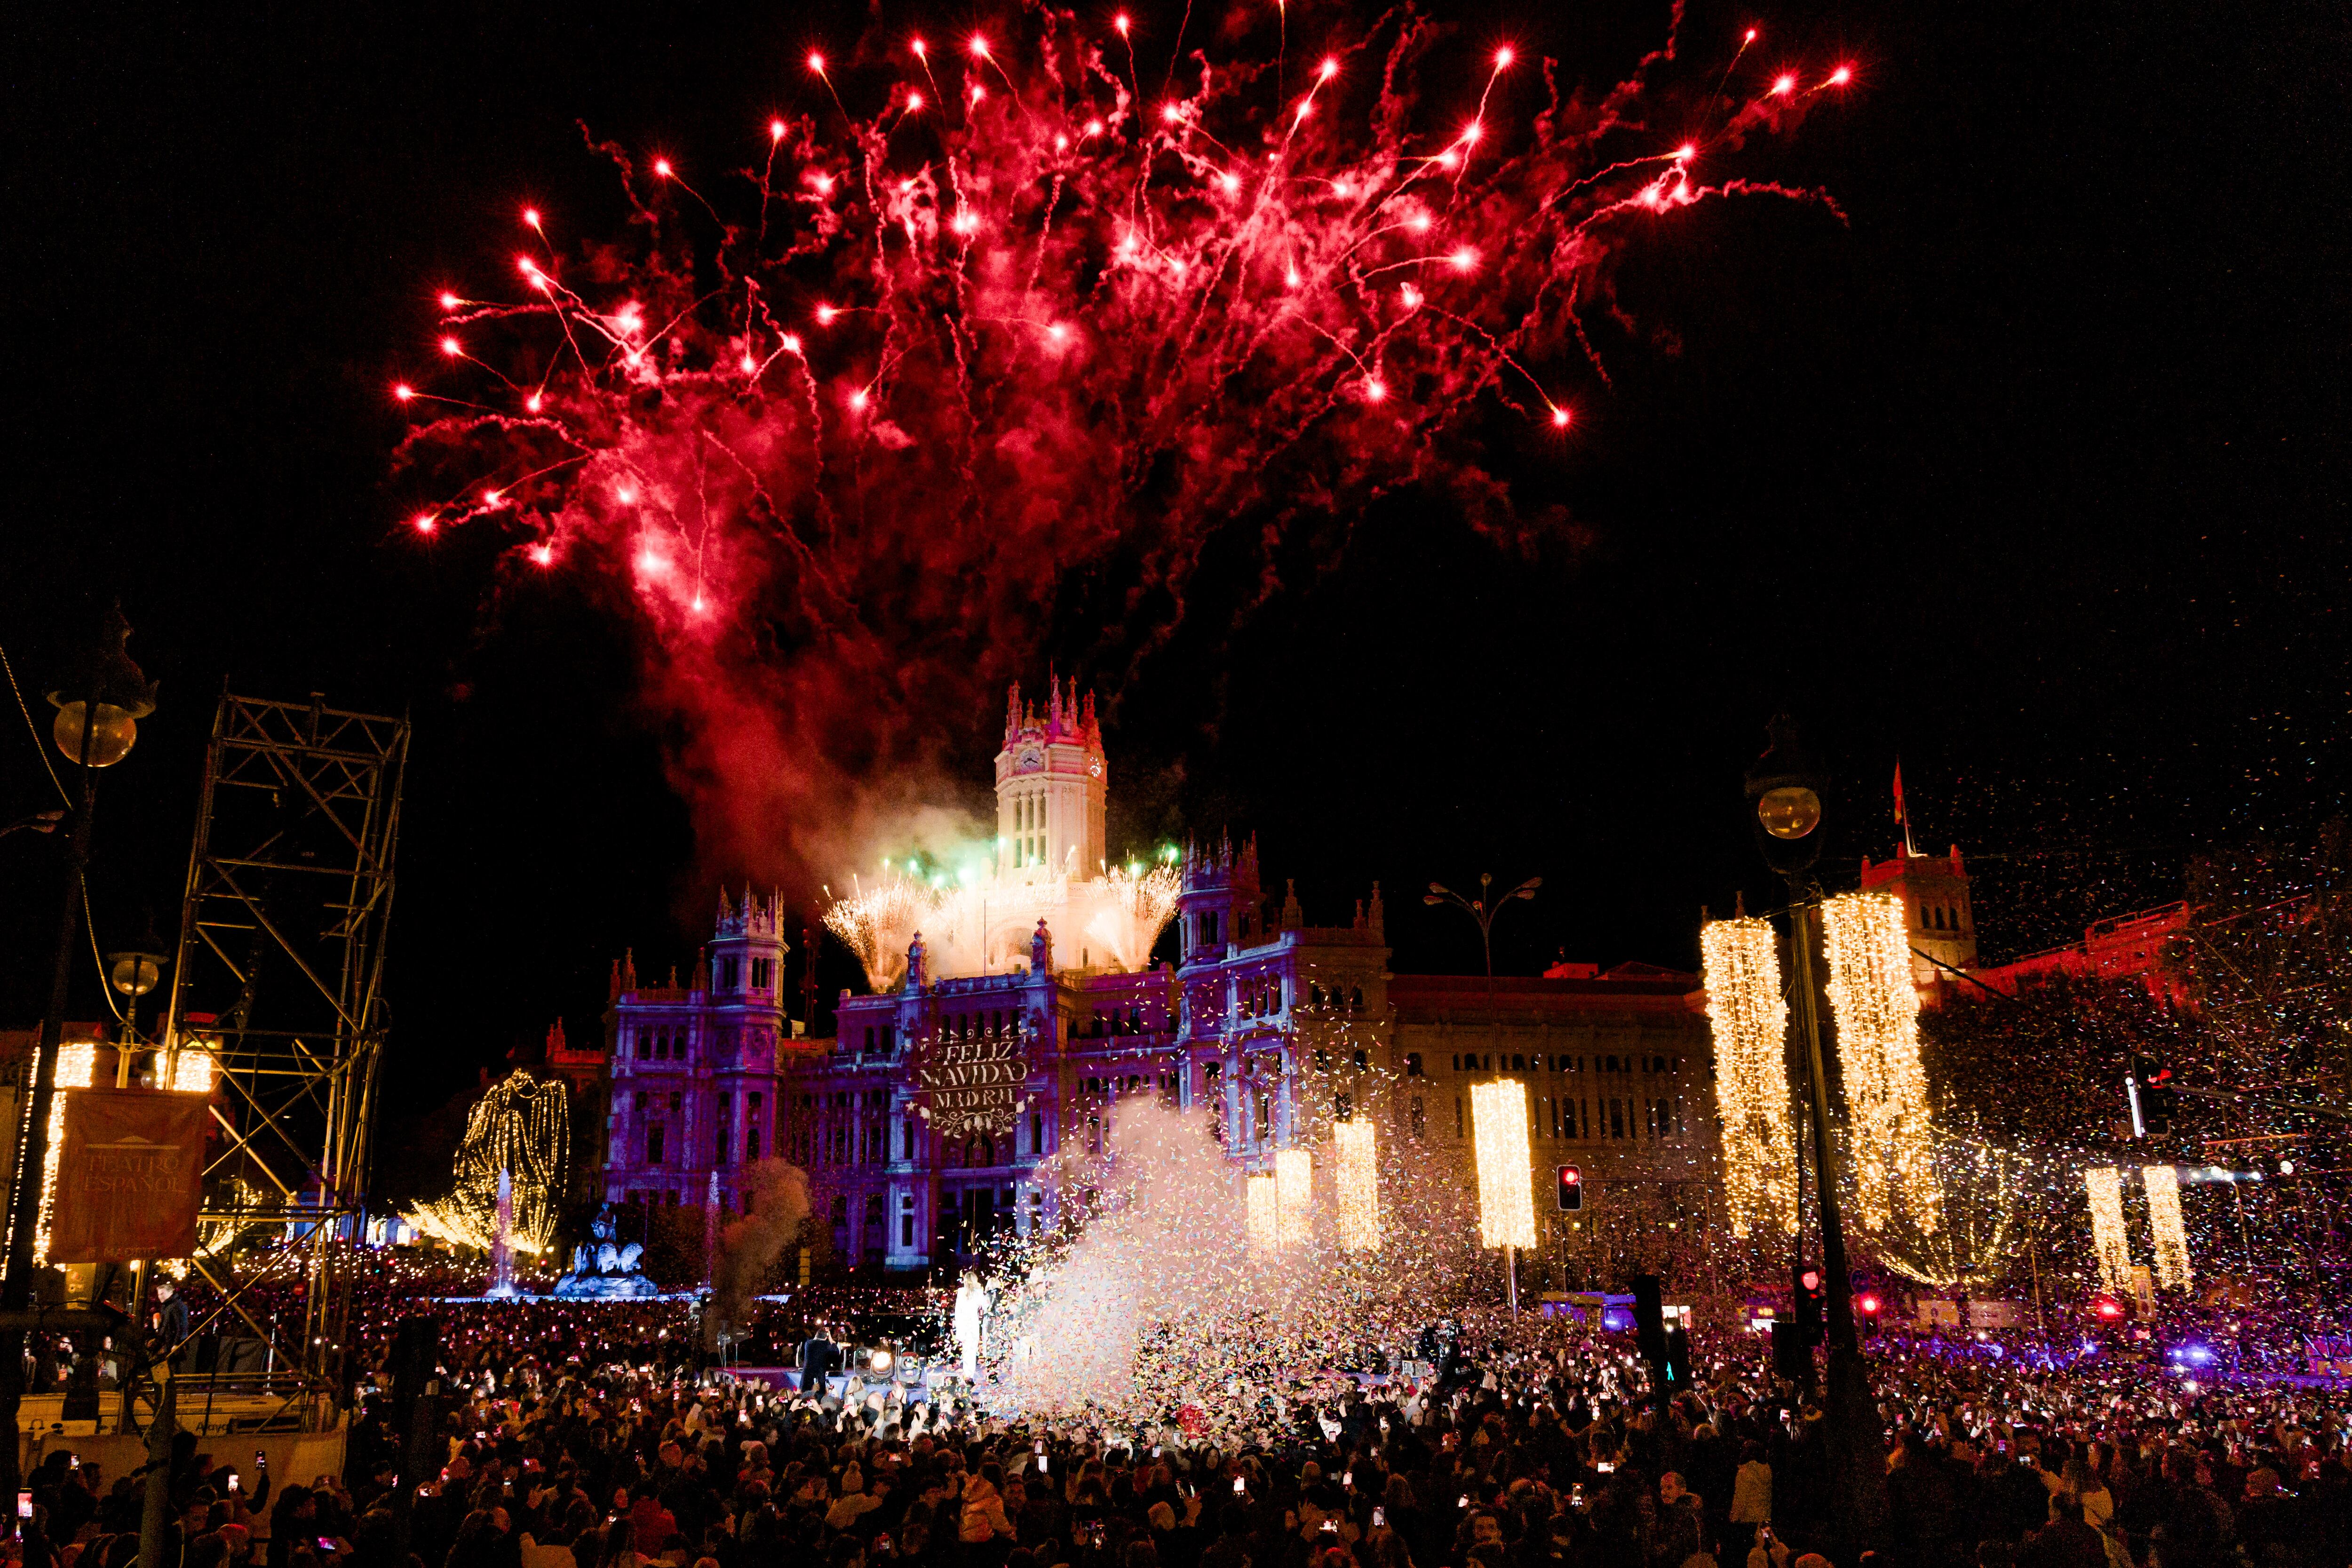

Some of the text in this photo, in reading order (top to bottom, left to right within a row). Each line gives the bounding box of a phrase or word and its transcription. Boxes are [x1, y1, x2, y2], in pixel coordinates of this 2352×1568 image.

[942, 1041, 1014, 1066] FELIZ
[919, 1061, 1028, 1088] NAVIDAD
[83, 1155, 179, 1174] TEATRO
[83, 1174, 188, 1194] ESPAÑOL
